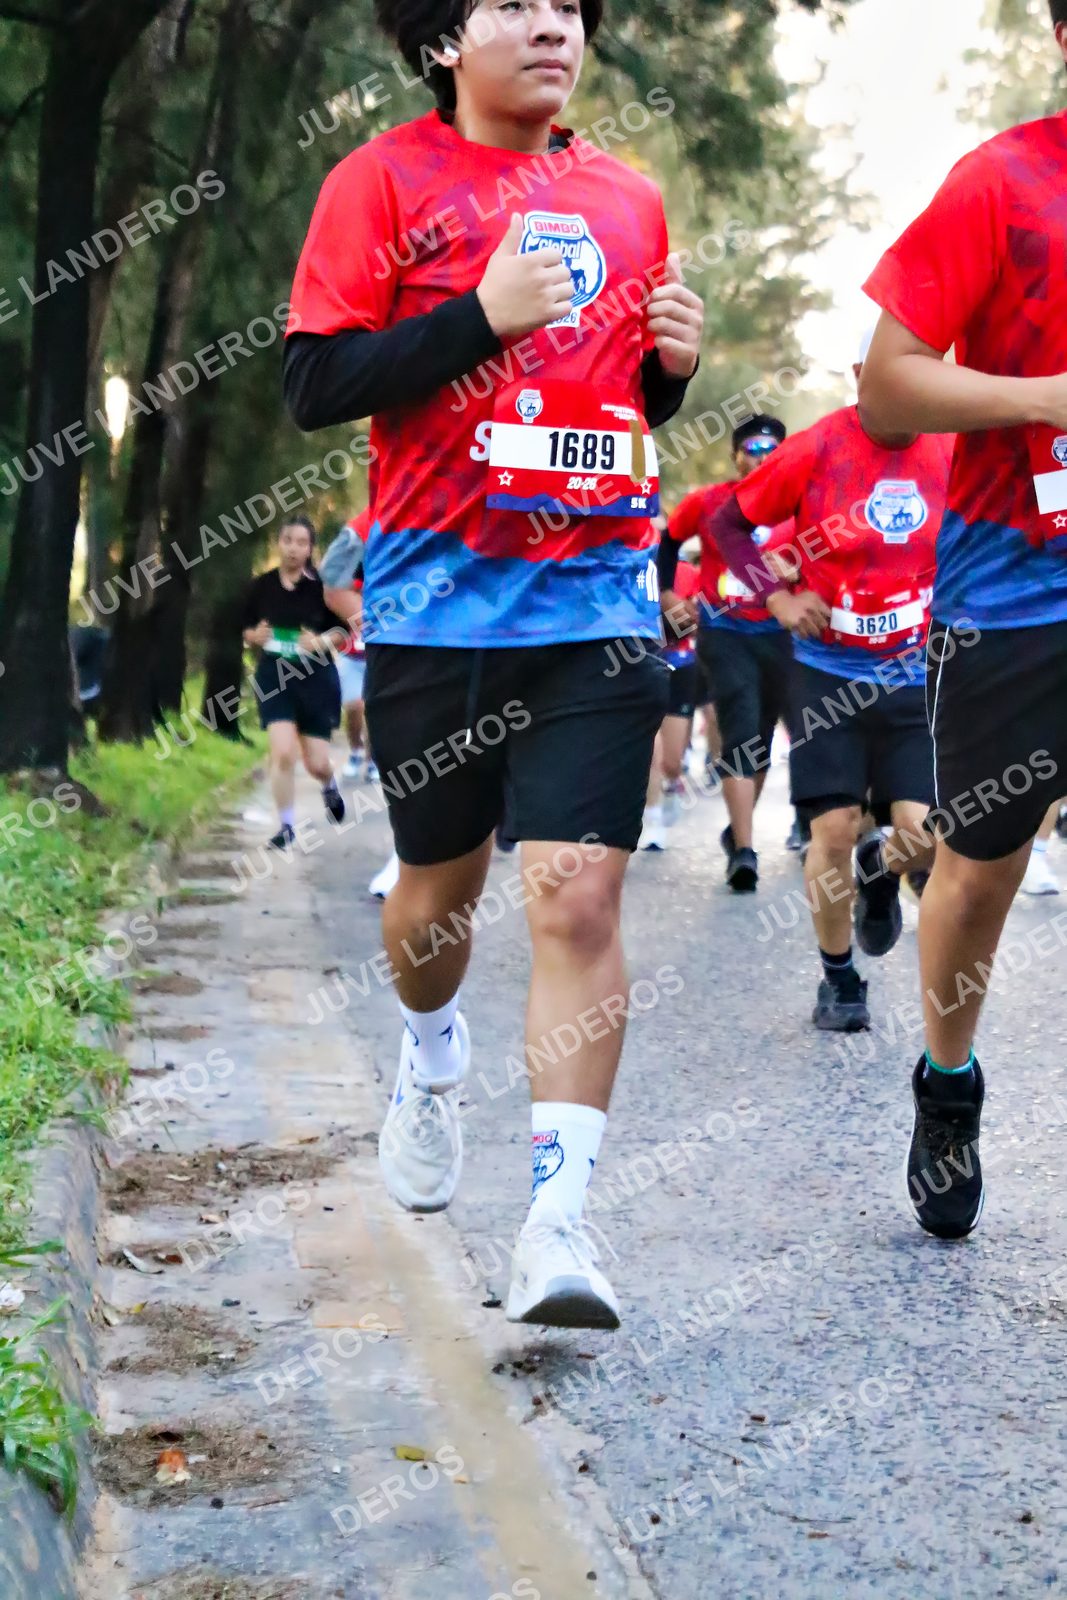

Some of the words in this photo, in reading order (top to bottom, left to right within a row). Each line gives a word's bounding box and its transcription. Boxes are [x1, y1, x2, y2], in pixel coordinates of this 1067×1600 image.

[534, 221, 580, 234] BIMBO
[549, 431, 615, 470] 1689
[630, 497, 647, 508] 5K
[856, 612, 898, 634] 3620
